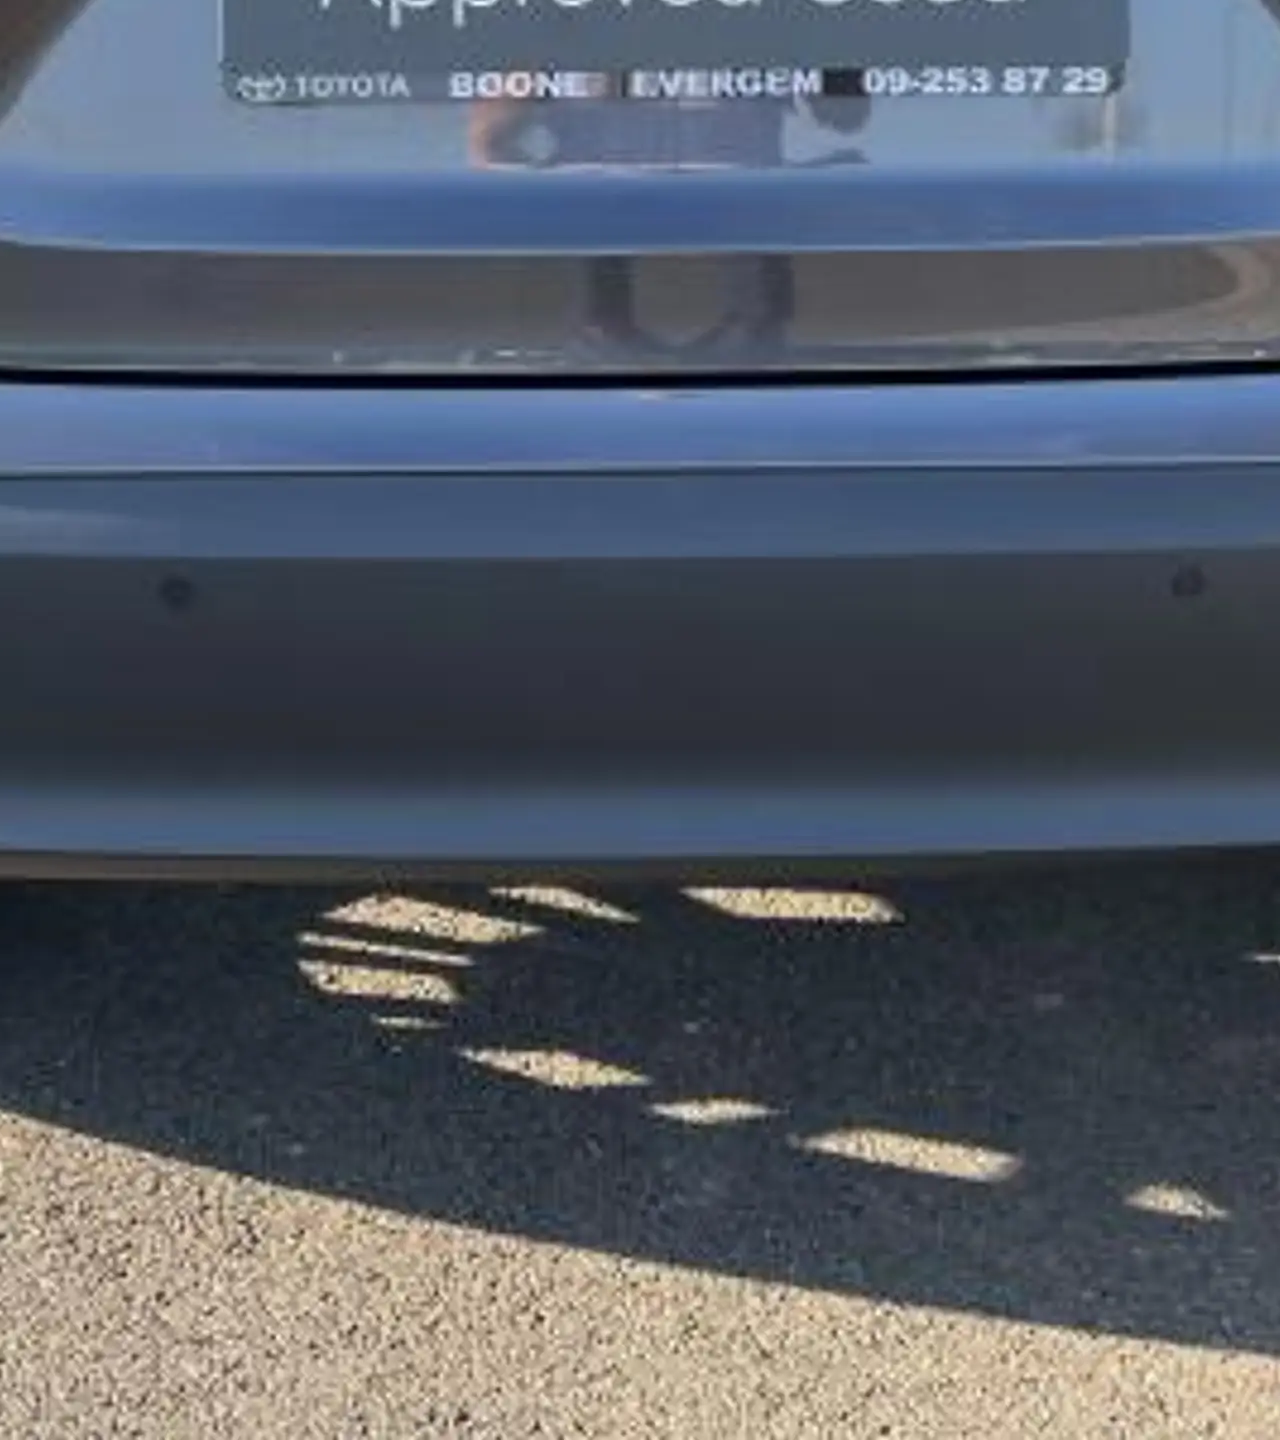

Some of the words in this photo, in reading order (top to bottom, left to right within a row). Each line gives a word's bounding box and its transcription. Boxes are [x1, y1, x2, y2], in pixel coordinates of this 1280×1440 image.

[296, 73, 411, 98] TOYOTA
[449, 71, 588, 98] BOONE
[631, 68, 822, 97] EVERGEM
[864, 67, 991, 95] 09-253
[1001, 67, 1048, 94] 87
[1062, 66, 1108, 93] 29
